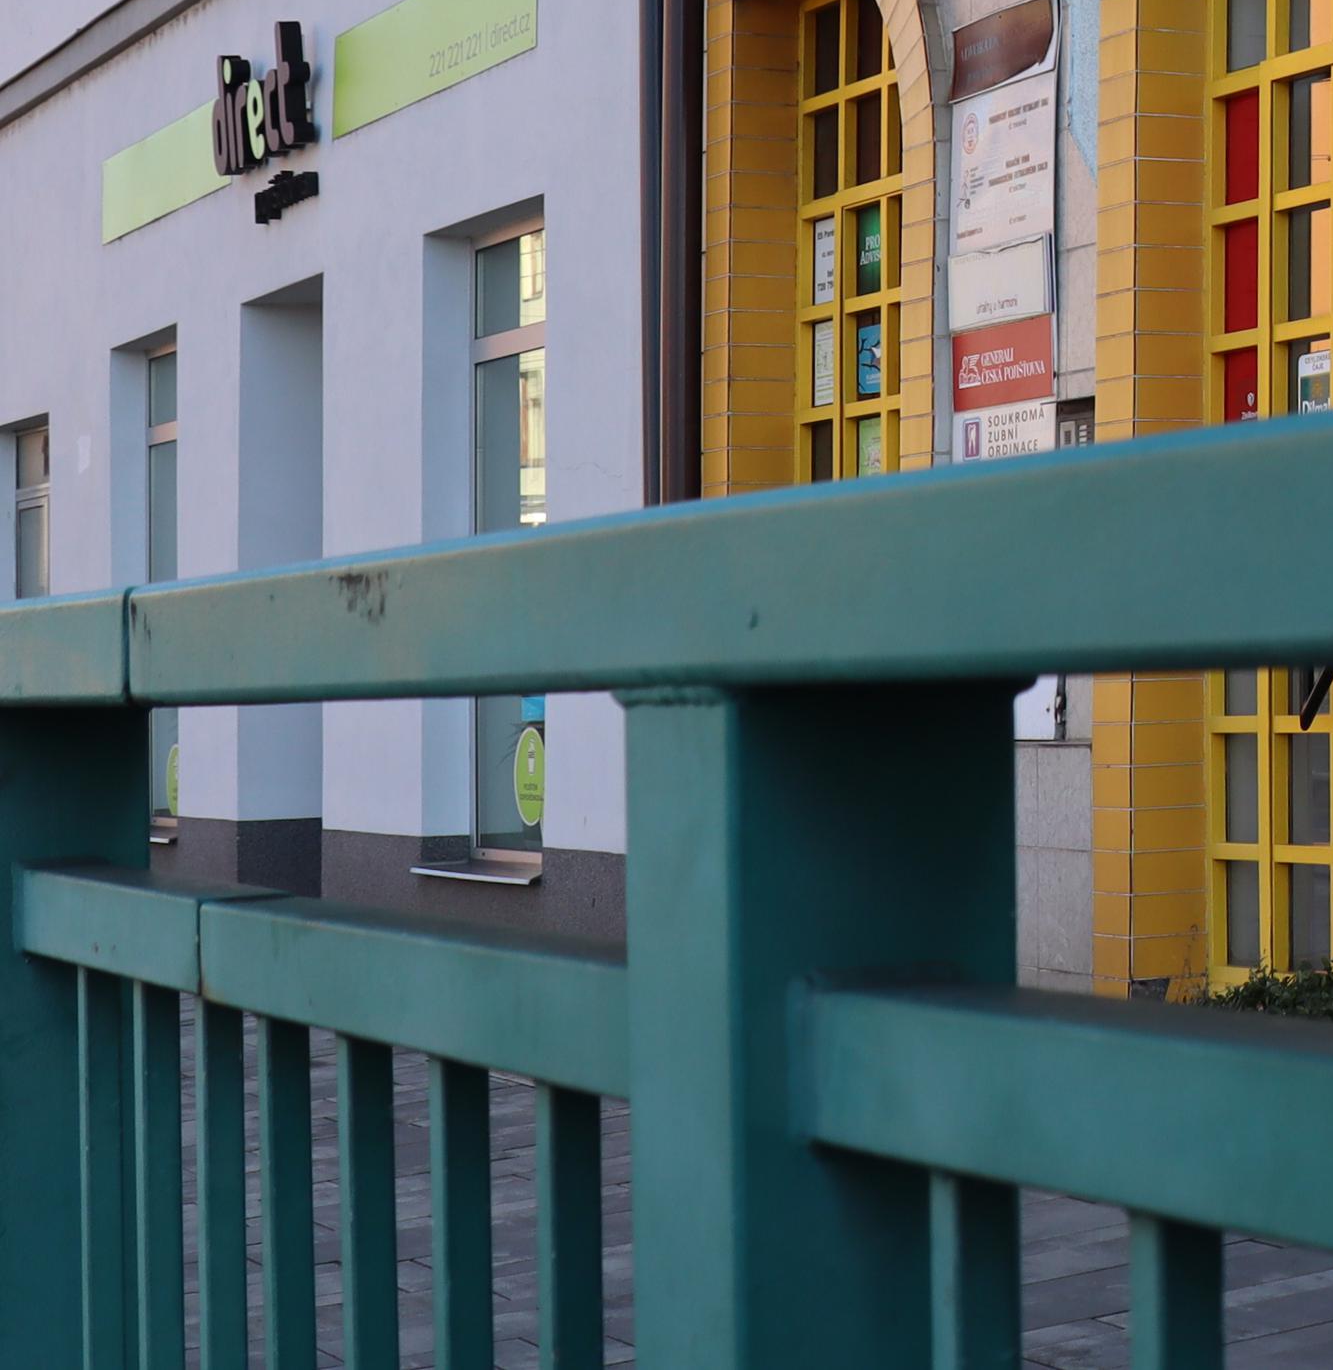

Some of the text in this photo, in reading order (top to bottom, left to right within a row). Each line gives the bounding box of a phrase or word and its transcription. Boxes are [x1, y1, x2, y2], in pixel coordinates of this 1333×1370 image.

[429, 50, 446, 78] 221
[447, 39, 464, 69] 221
[466, 31, 482, 61] 221
[212, 21, 300, 177] direct
[980, 347, 1014, 367] GENERALI
[981, 366, 1003, 385] ČESKÁ
[987, 406, 1045, 429] SOUKROMÁ
[987, 424, 1019, 444] ZUBNÍ
[987, 439, 1039, 458] ORDINACE
